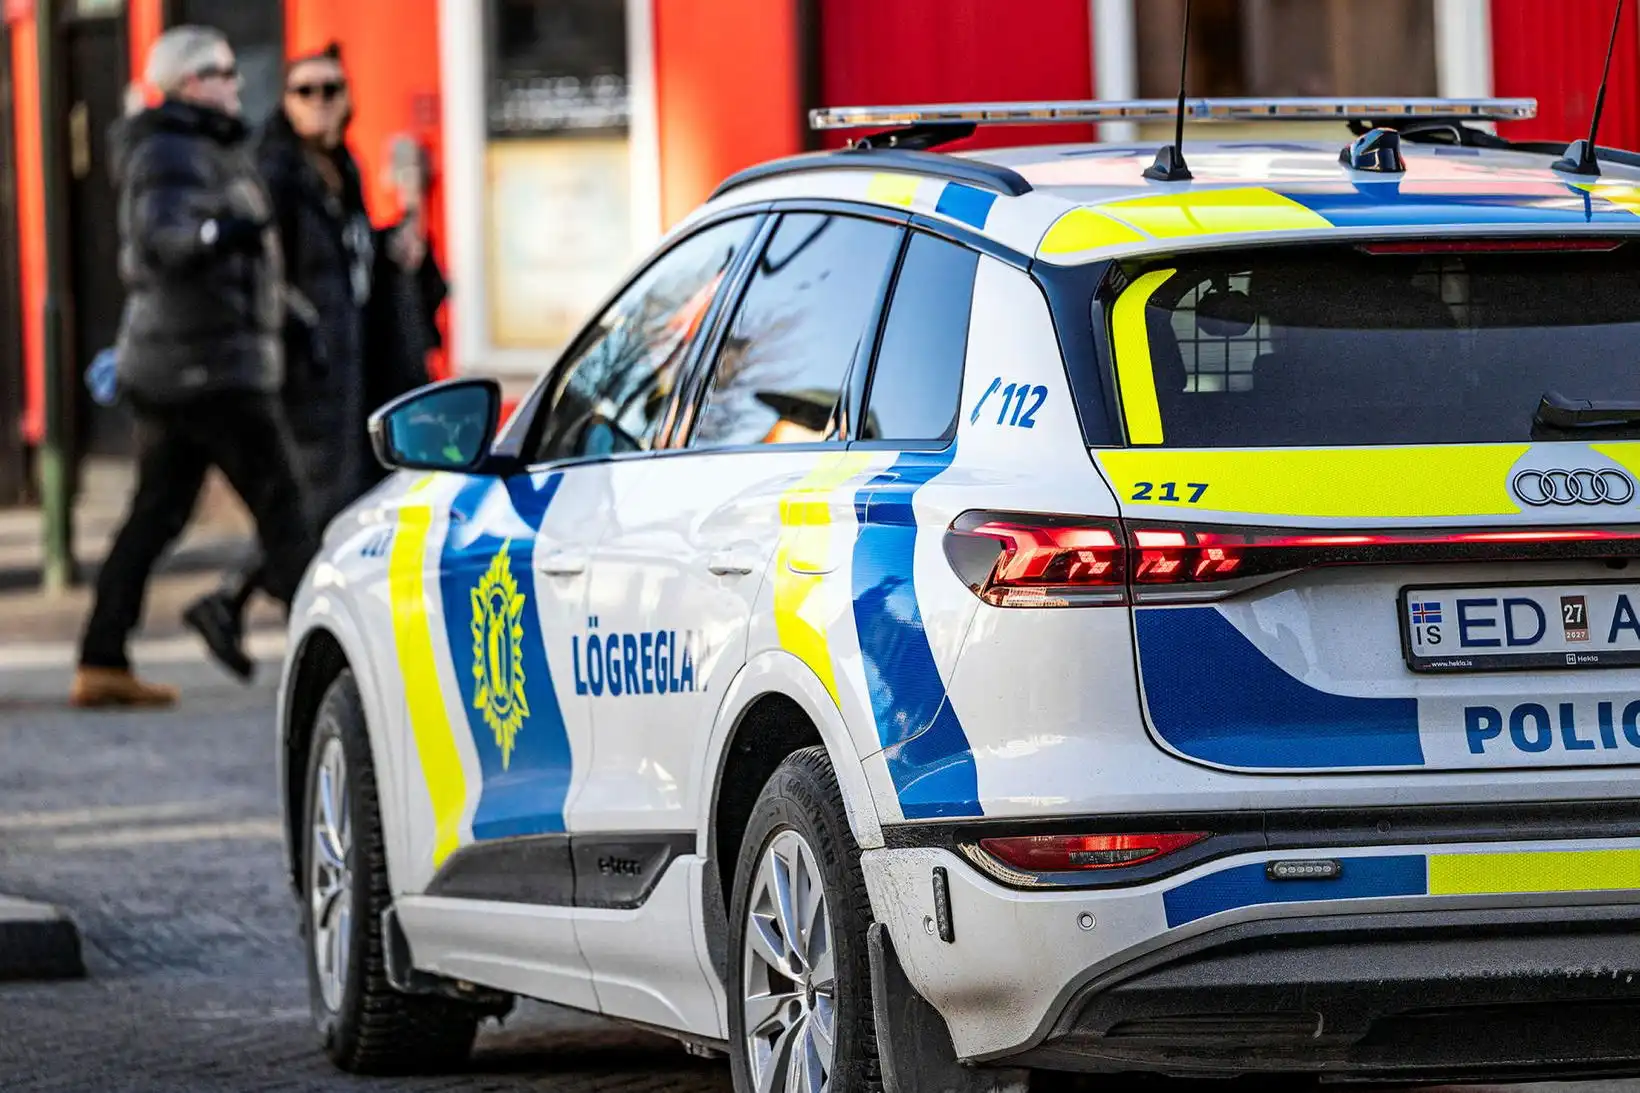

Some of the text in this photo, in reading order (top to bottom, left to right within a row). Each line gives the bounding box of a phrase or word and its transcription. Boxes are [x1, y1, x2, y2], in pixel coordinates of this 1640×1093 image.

[996, 383, 1048, 428] 112
[1131, 481, 1208, 503] 217
[1456, 594, 1640, 648] ED A
[1563, 604, 1583, 623] 27
[1416, 624, 1443, 646] IS
[1566, 631, 1587, 639] 2027
[1431, 660, 1473, 668] www.hekla.is
